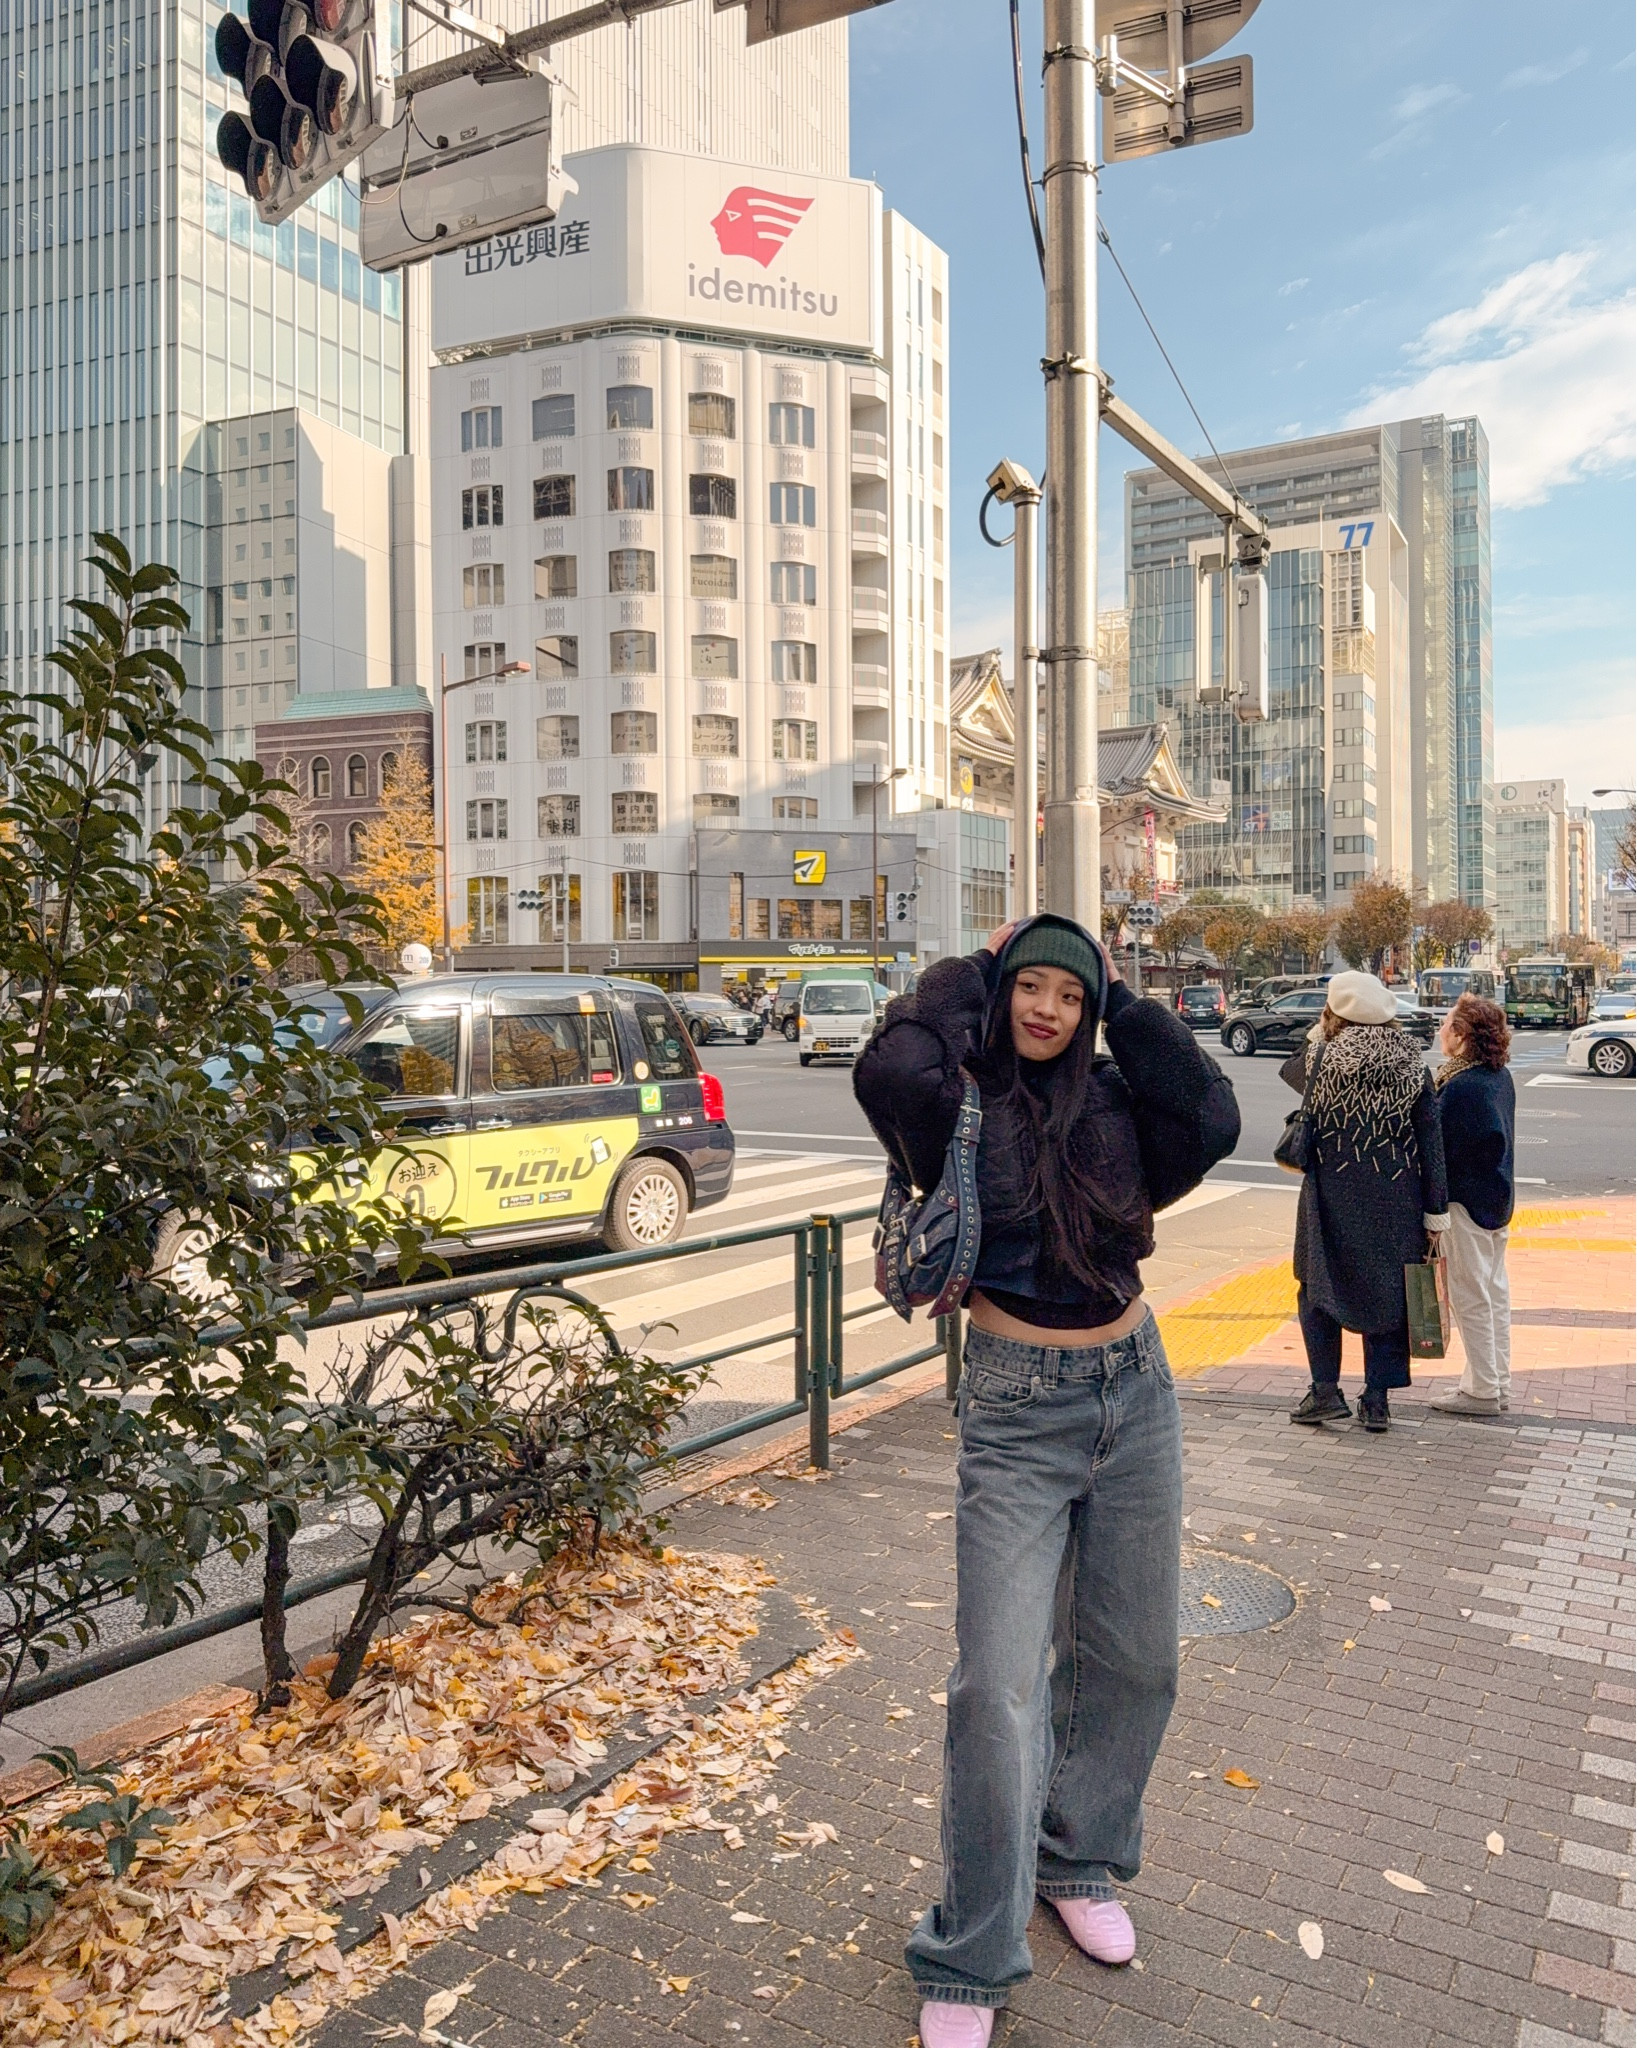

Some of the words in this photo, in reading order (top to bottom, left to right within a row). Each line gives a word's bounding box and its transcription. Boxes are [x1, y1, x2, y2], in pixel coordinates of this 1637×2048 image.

[465, 220, 590, 276] 出光興産
[688, 262, 838, 317] idemitsu
[1339, 521, 1375, 550] 77
[692, 576, 734, 588] Fucoidan
[694, 731, 734, 741] レーシック
[692, 743, 738, 754] 白内障手術
[518, 1147, 561, 1157] タクシーアプリ
[398, 1162, 440, 1183] お迎え
[427, 1205, 437, 1217] 円
